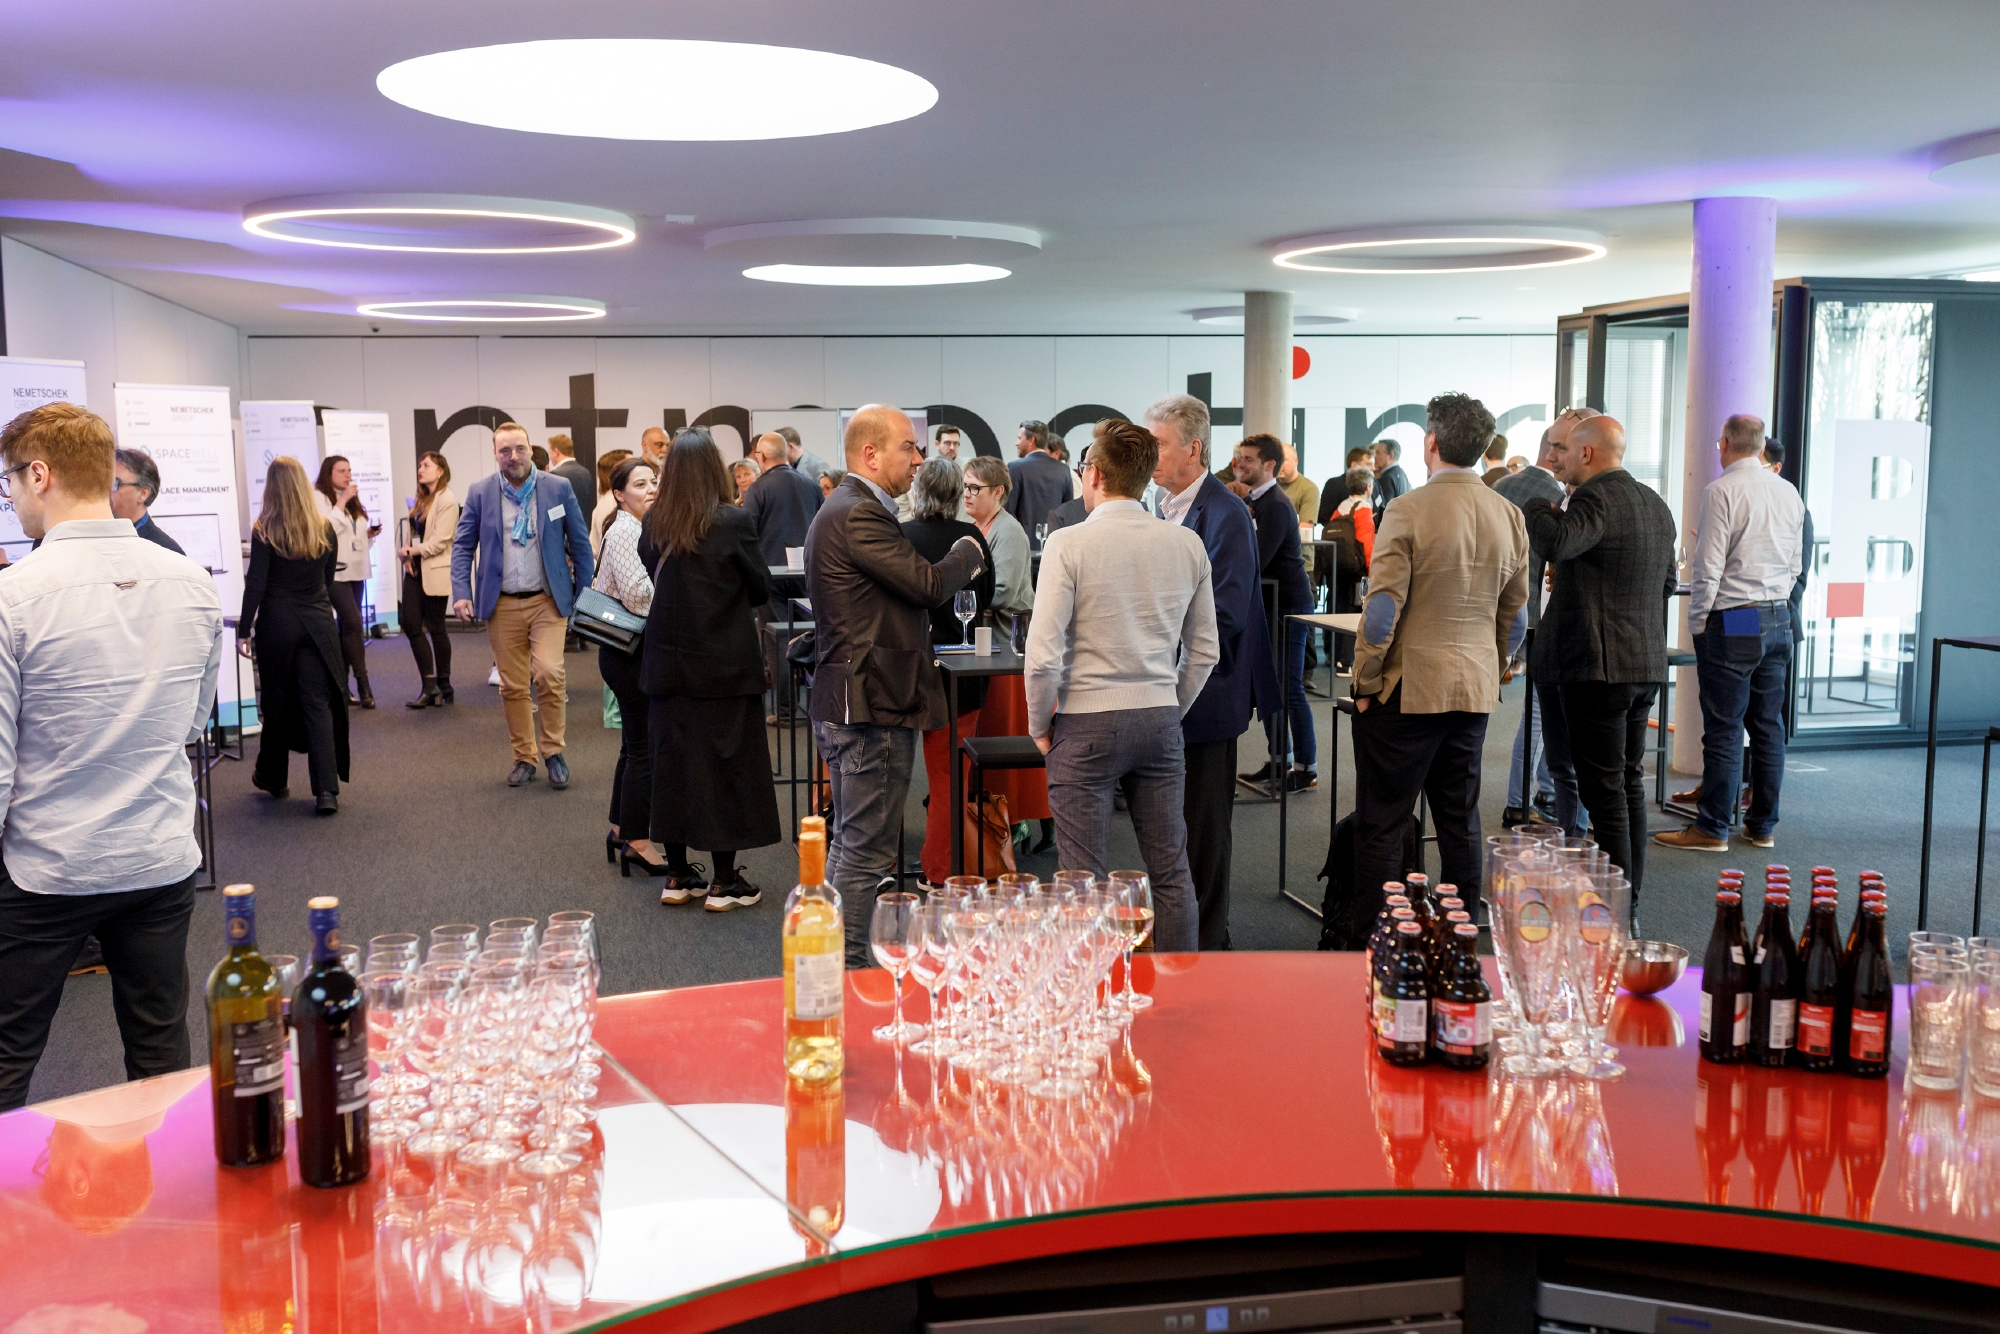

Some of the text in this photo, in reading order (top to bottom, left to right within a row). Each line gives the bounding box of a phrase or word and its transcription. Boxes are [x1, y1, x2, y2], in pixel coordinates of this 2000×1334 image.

[13, 387, 68, 399] NEMETSCHEK
[170, 406, 215, 415] NEMETSCHEK
[159, 485, 230, 495] LACE MANAGEMENT
